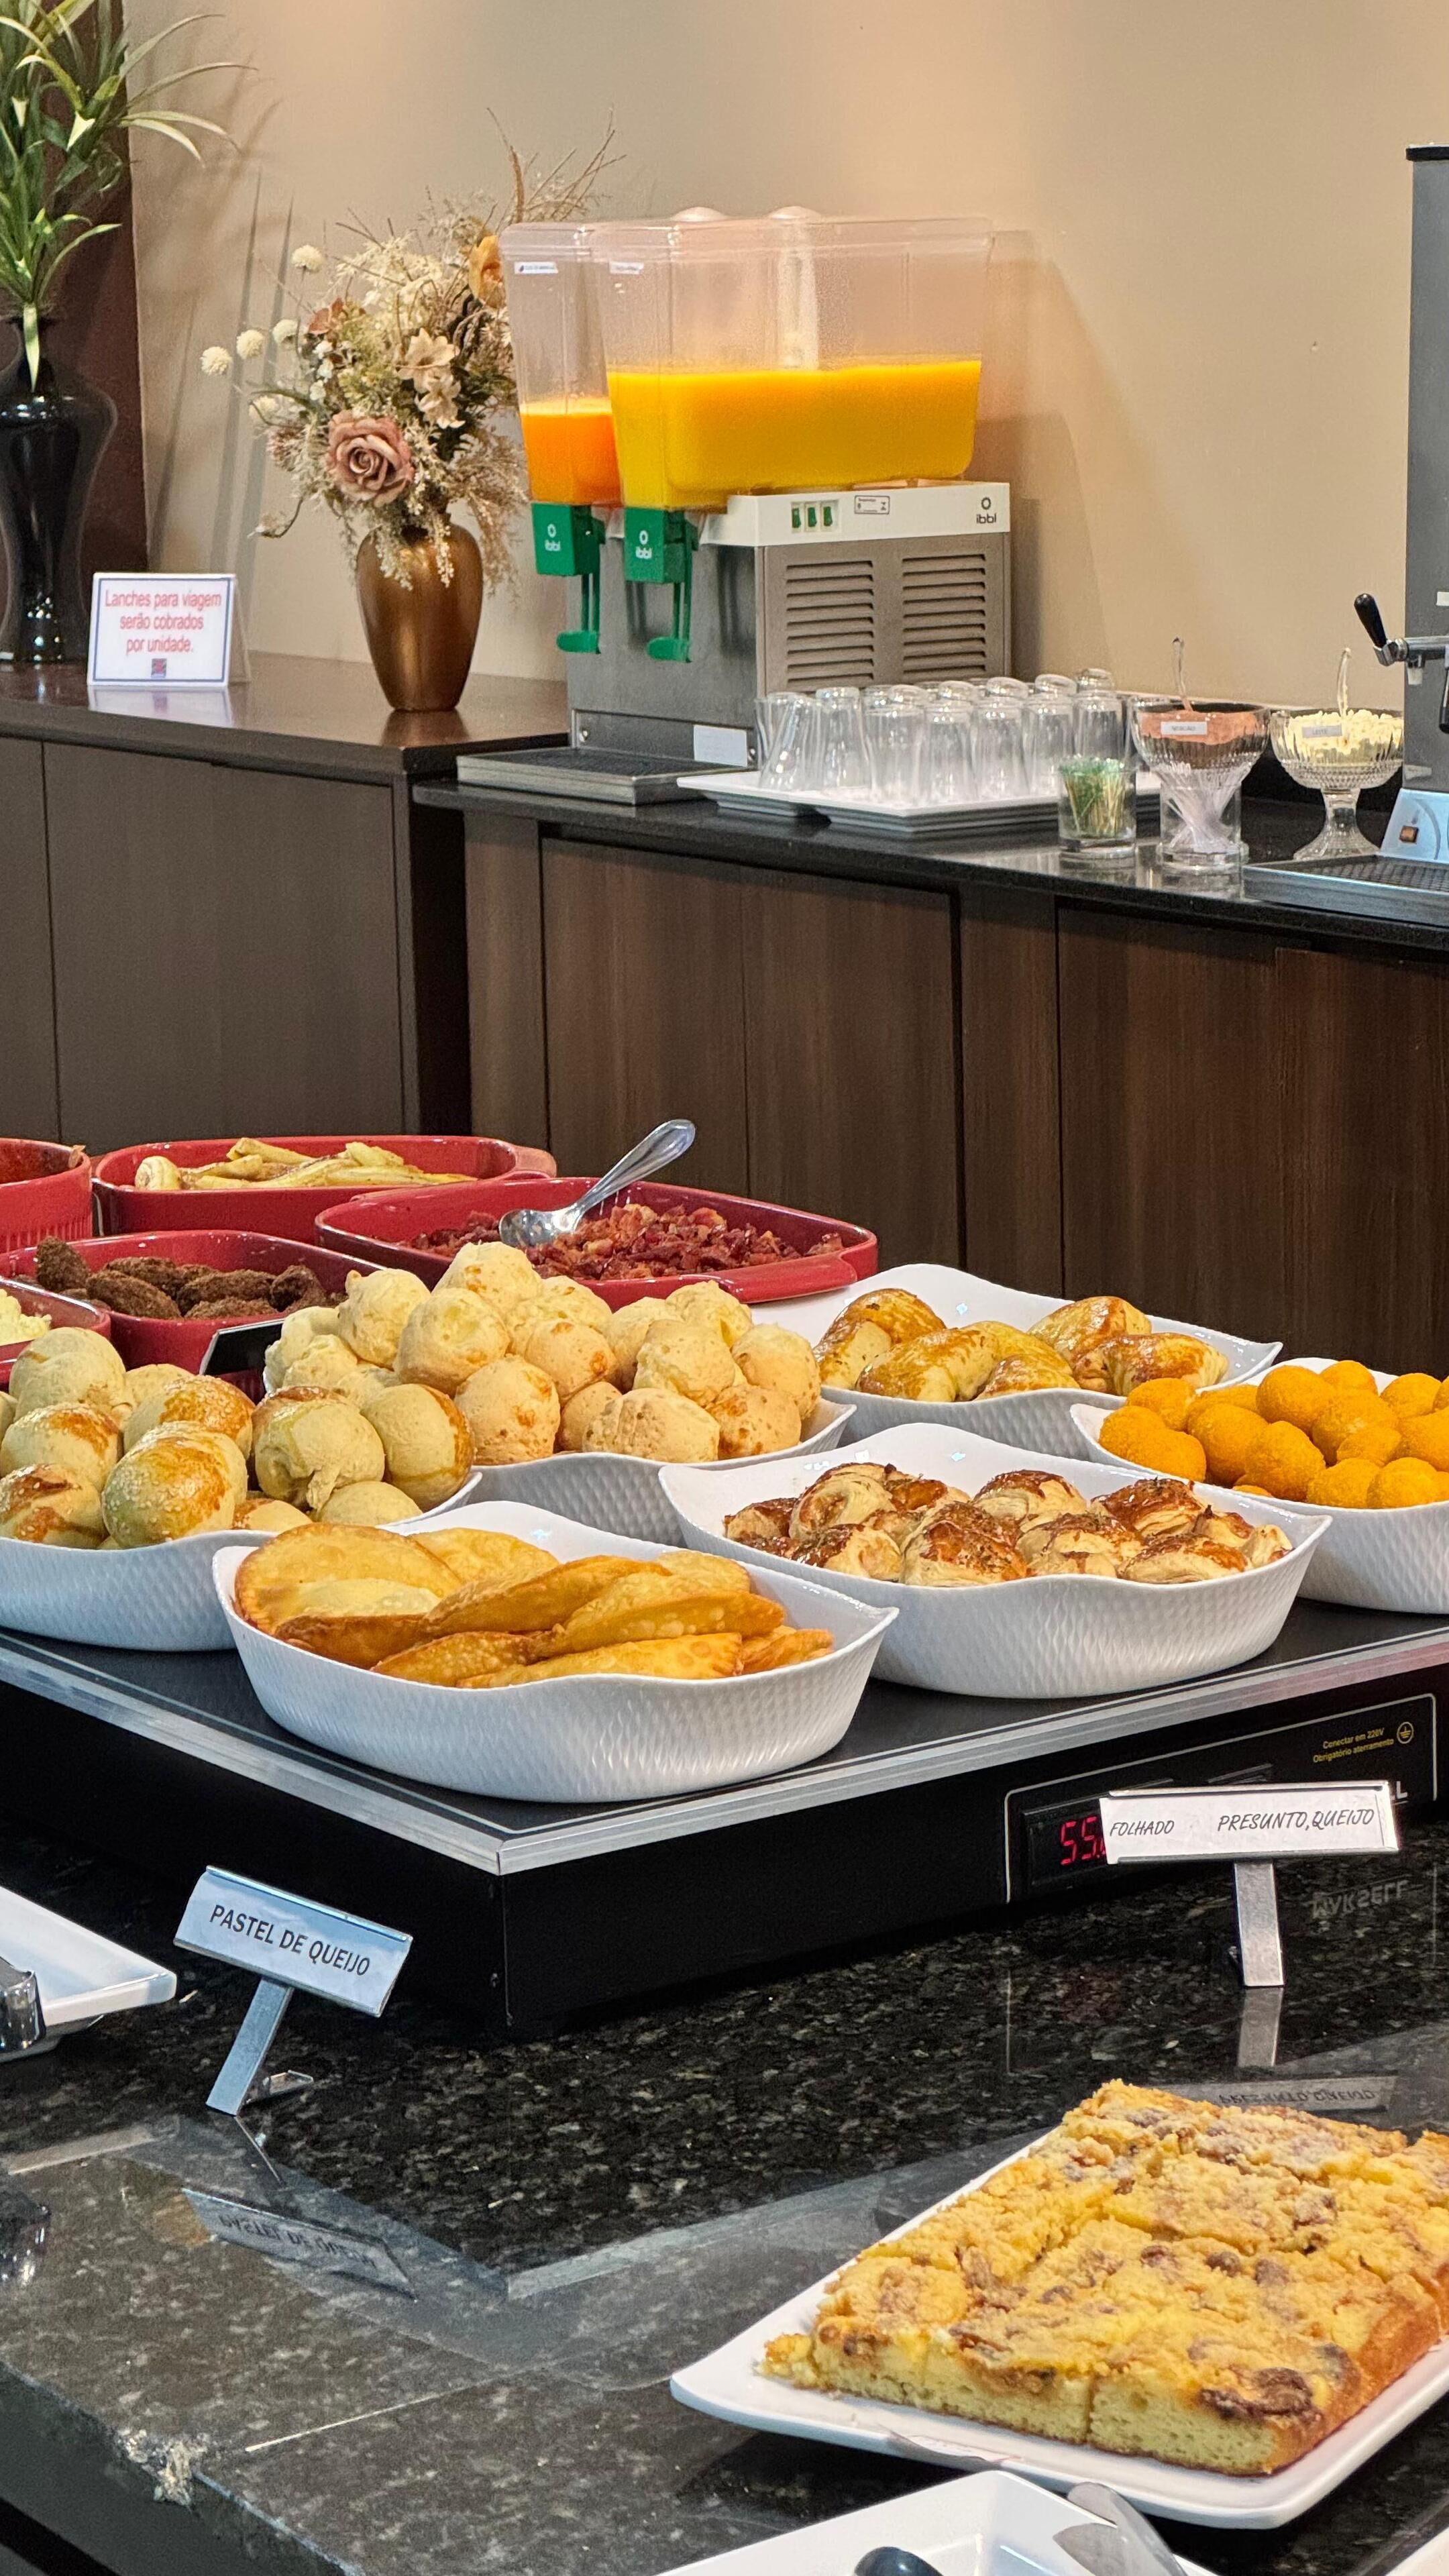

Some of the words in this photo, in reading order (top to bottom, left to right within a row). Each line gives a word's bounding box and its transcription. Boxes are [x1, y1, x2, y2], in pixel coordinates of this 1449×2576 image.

[976, 513, 996, 524] ibbl
[105, 590, 151, 607] Lanches
[154, 593, 178, 610] para
[182, 590, 222, 611] viagem
[120, 612, 151, 629] serão
[154, 613, 204, 630] cobrados
[126, 639, 145, 655] por
[148, 635, 194, 653] unidade.
[1323, 1736, 1354, 1750] Conectar
[1355, 1733, 1366, 1742] em
[1367, 1727, 1385, 1739] 220V
[1313, 1748, 1352, 1763] Obrigatório
[1352, 1738, 1395, 1754] aterramento
[1109, 1820, 1175, 1837] FOLHADO
[209, 1904, 274, 1945] PASTEL
[278, 1929, 307, 1954] DE
[309, 1941, 370, 1976] QUEIJO
